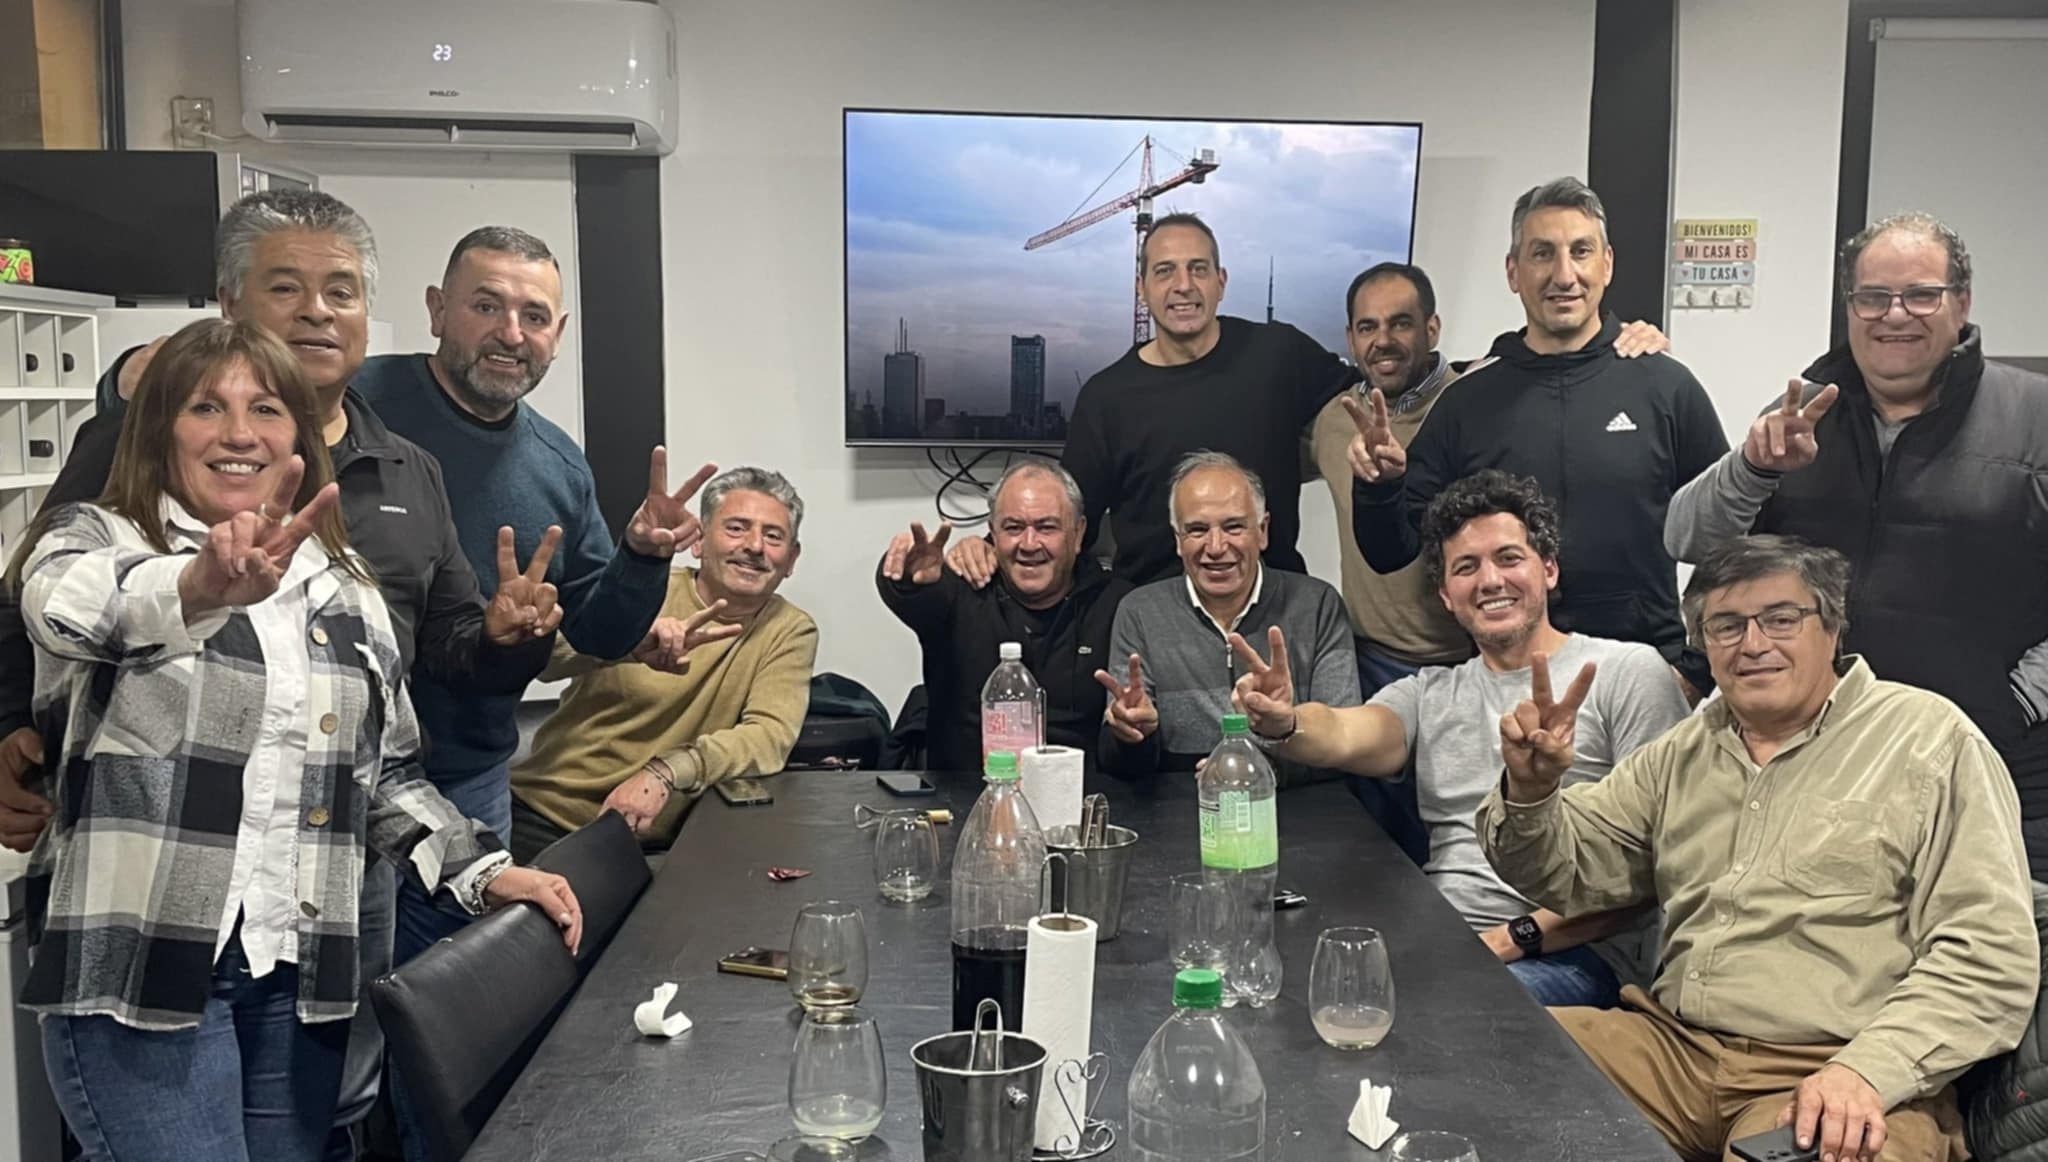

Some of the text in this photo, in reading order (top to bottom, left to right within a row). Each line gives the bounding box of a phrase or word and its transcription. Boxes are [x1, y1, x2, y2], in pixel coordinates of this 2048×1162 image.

[432, 44, 452, 61] 23
[1683, 224, 1752, 236] BIENVENIDOS!
[1684, 245, 1749, 258] MI CASA ES
[1692, 267, 1738, 280] TU CASA
